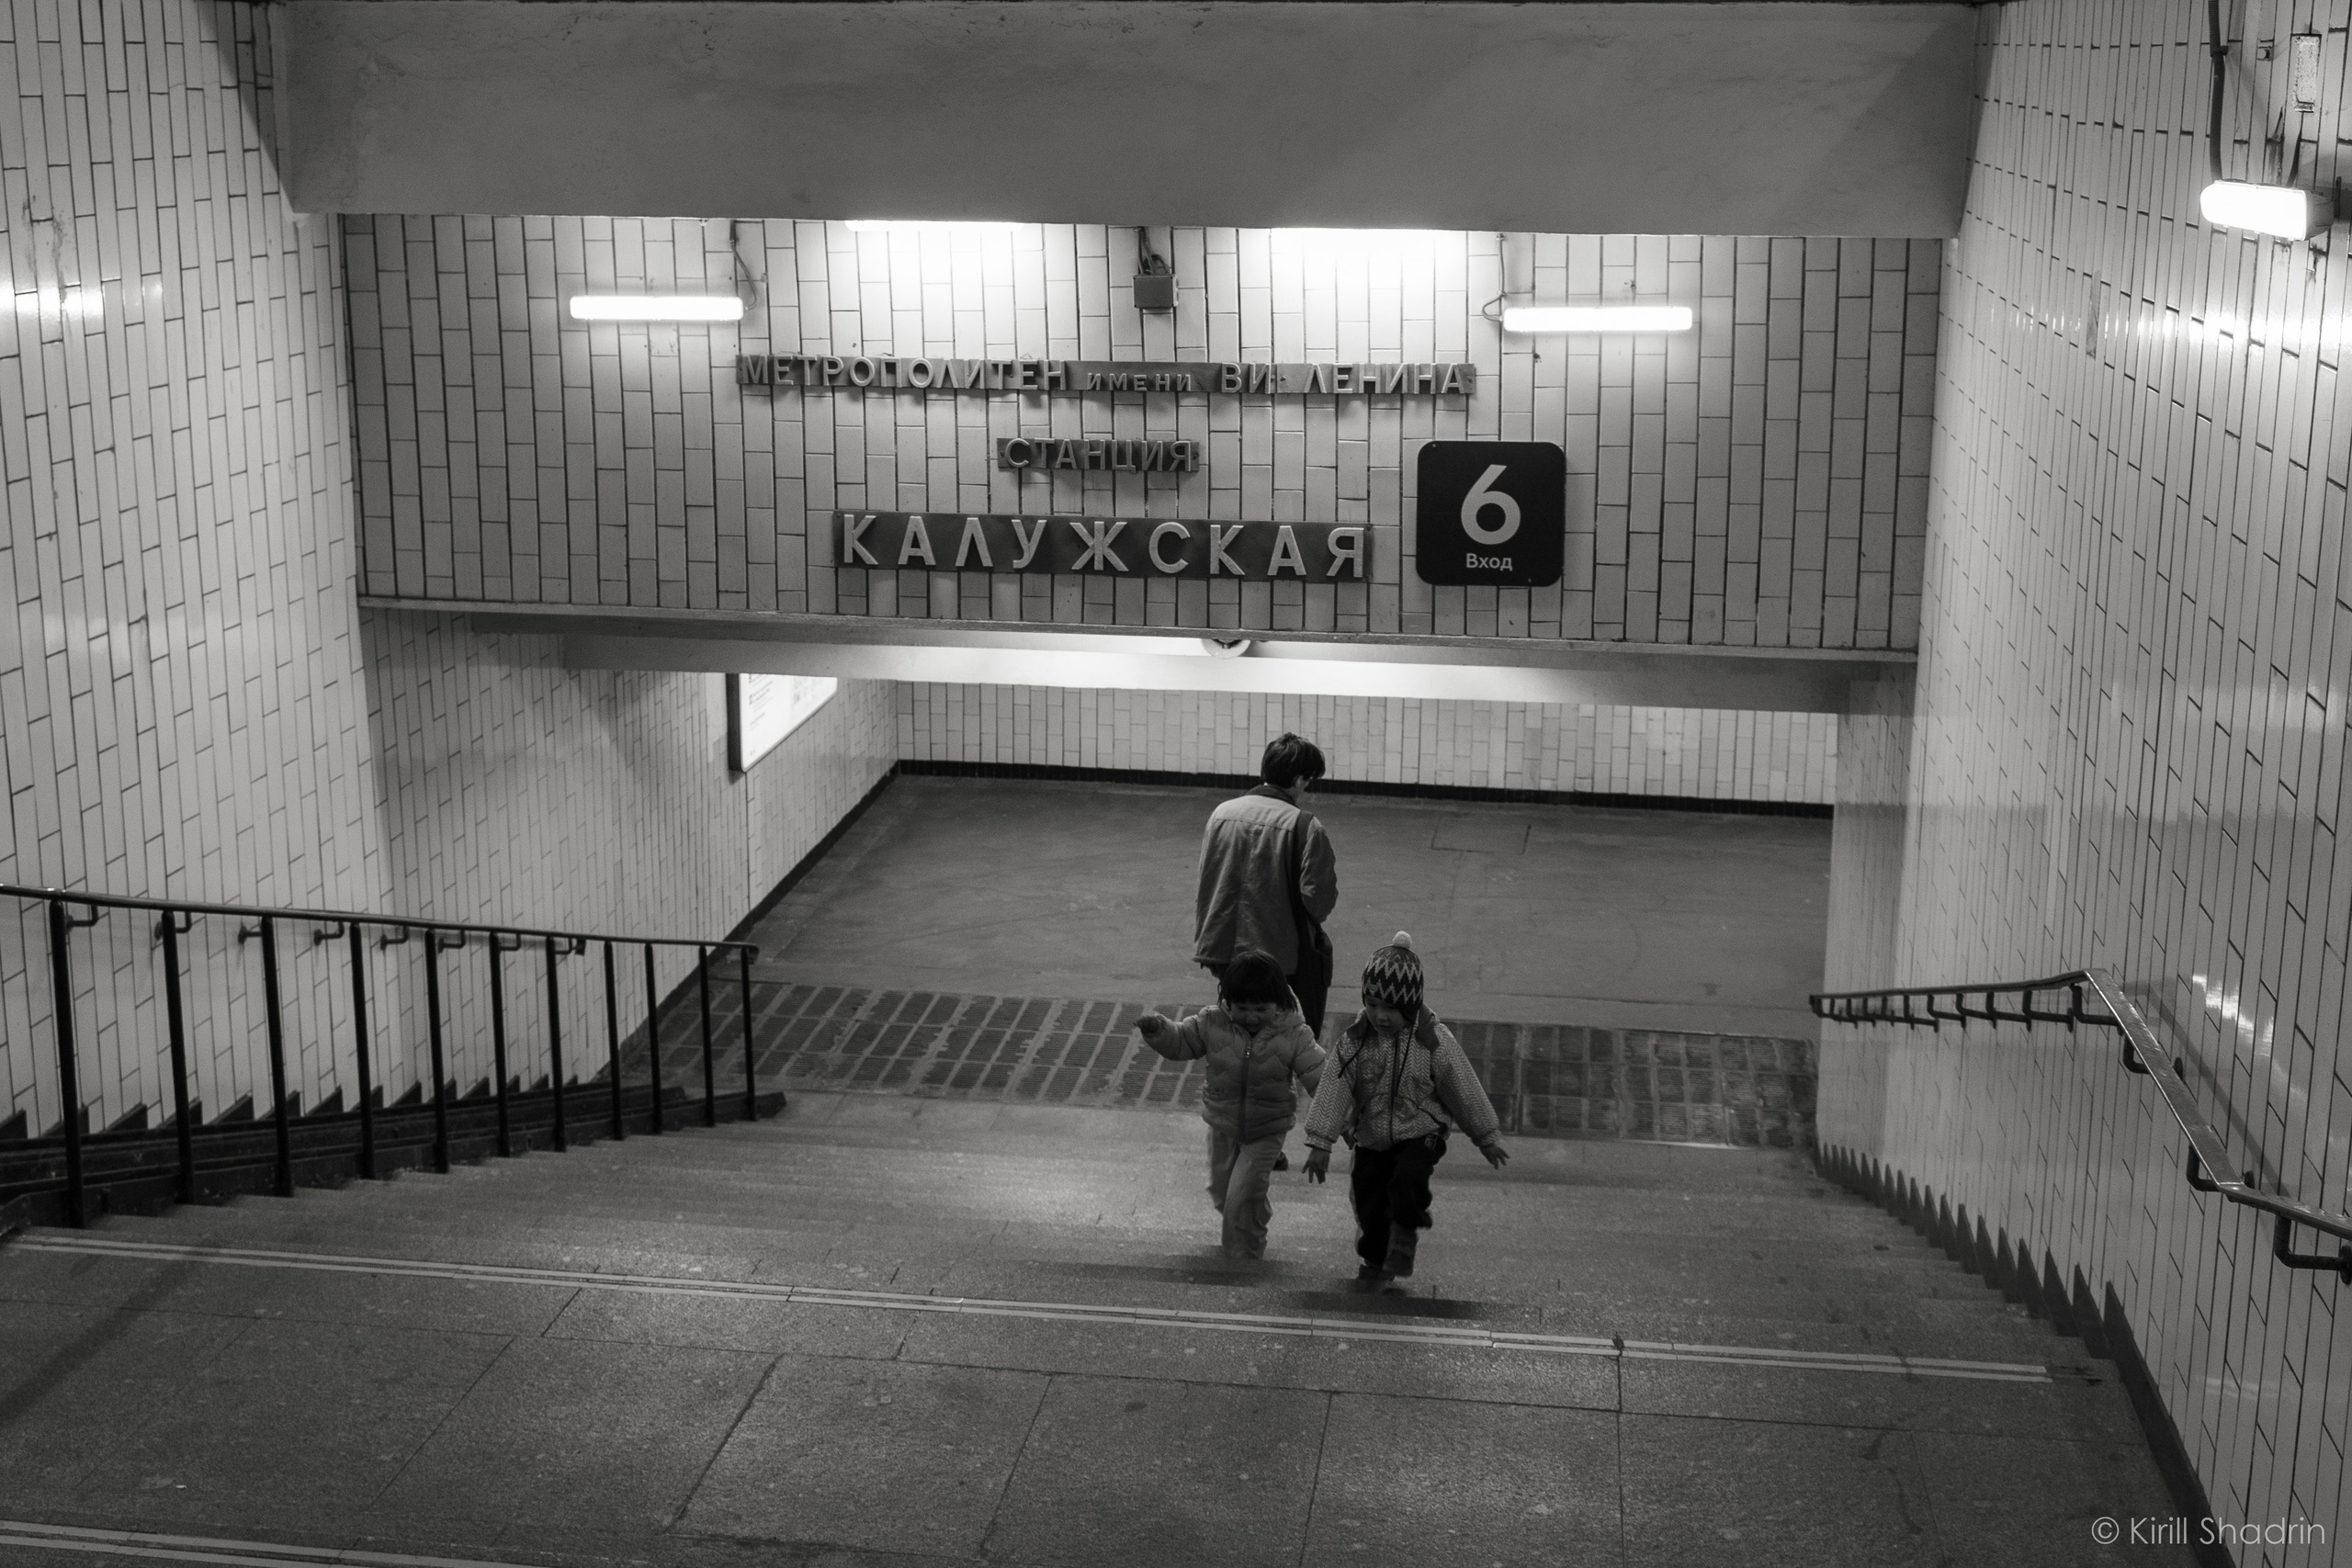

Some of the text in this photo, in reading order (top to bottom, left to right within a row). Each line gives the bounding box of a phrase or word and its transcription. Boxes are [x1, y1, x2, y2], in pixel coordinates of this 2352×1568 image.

[741, 355, 1067, 389] МЕТРОПОЛИТЕН
[1304, 363, 1468, 394] ЛЕНИНА
[1006, 437, 1191, 473] СТАНЦИЯ
[1461, 464, 1521, 546] 6
[842, 513, 1364, 578] КАЛУЖСКАЯ
[1466, 553, 1513, 571] Вход
